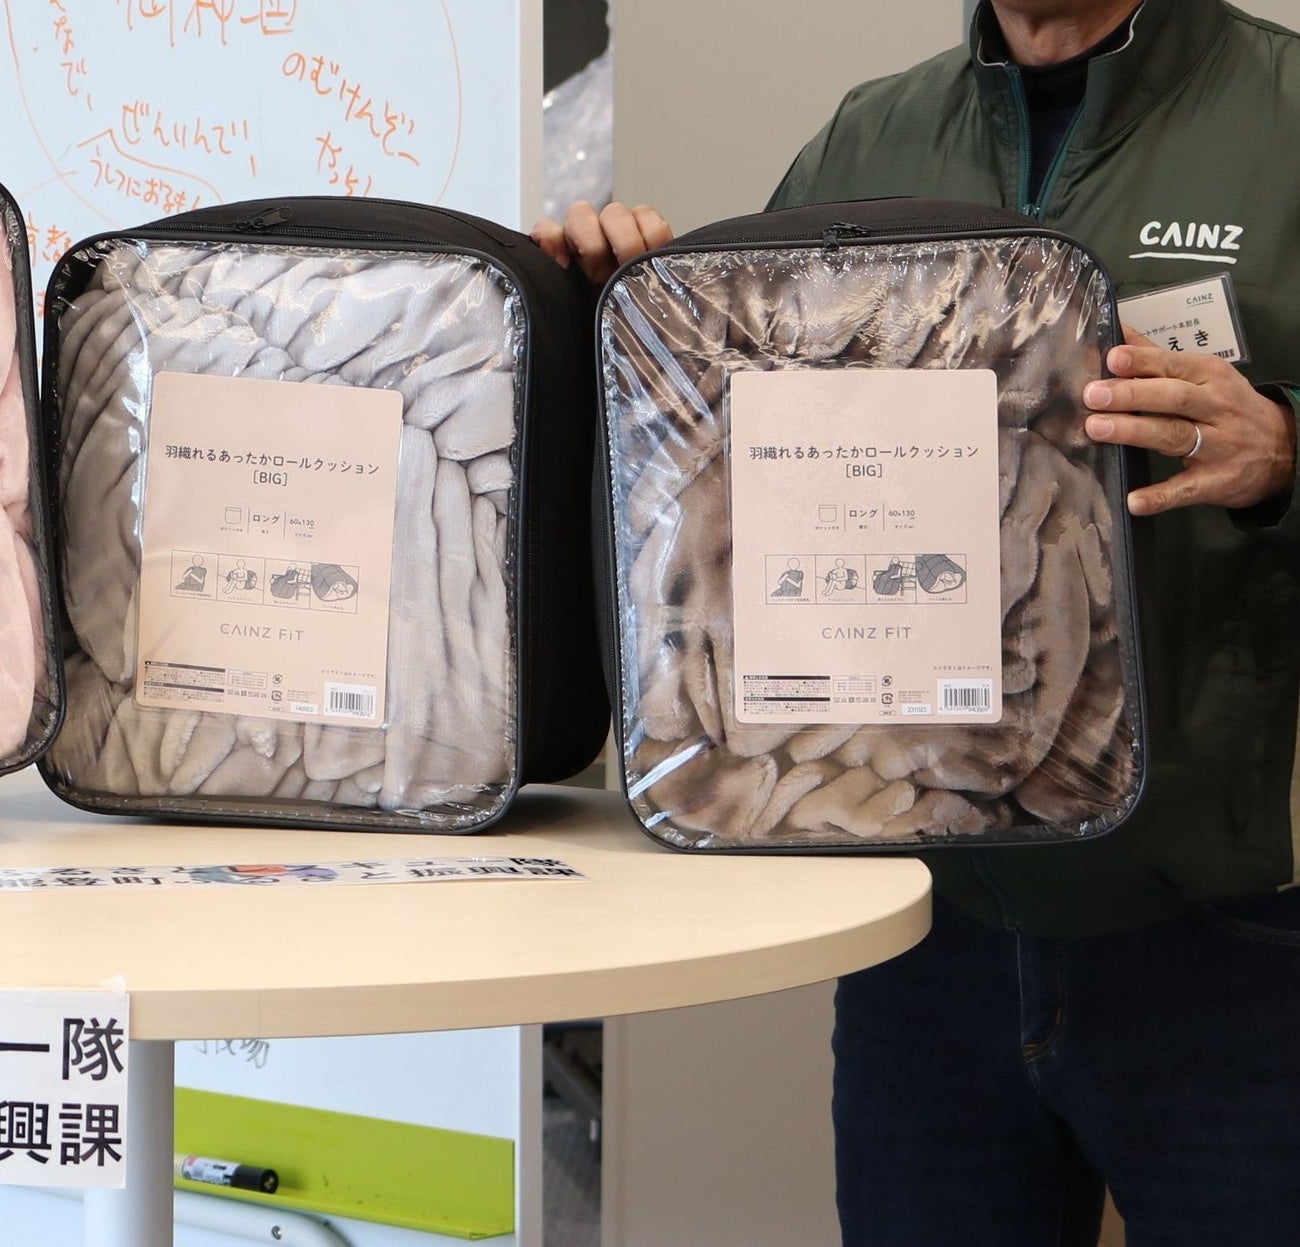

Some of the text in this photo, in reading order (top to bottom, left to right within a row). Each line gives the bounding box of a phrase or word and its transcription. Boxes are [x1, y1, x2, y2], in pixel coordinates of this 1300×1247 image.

[1139, 221, 1244, 250] CAINZ
[1185, 293, 1214, 305] CAINZ
[165, 444, 380, 475] 羽織れるあったかロールクッション
[749, 445, 979, 461] 羽織れるあったかロールクッション
[252, 469, 288, 486] [BIG]
[845, 463, 883, 478] [BIG]
[252, 513, 280, 524] ロング
[849, 508, 878, 519] ロング
[220, 622, 271, 639] CAINZ
[821, 627, 877, 640] CAINZ
